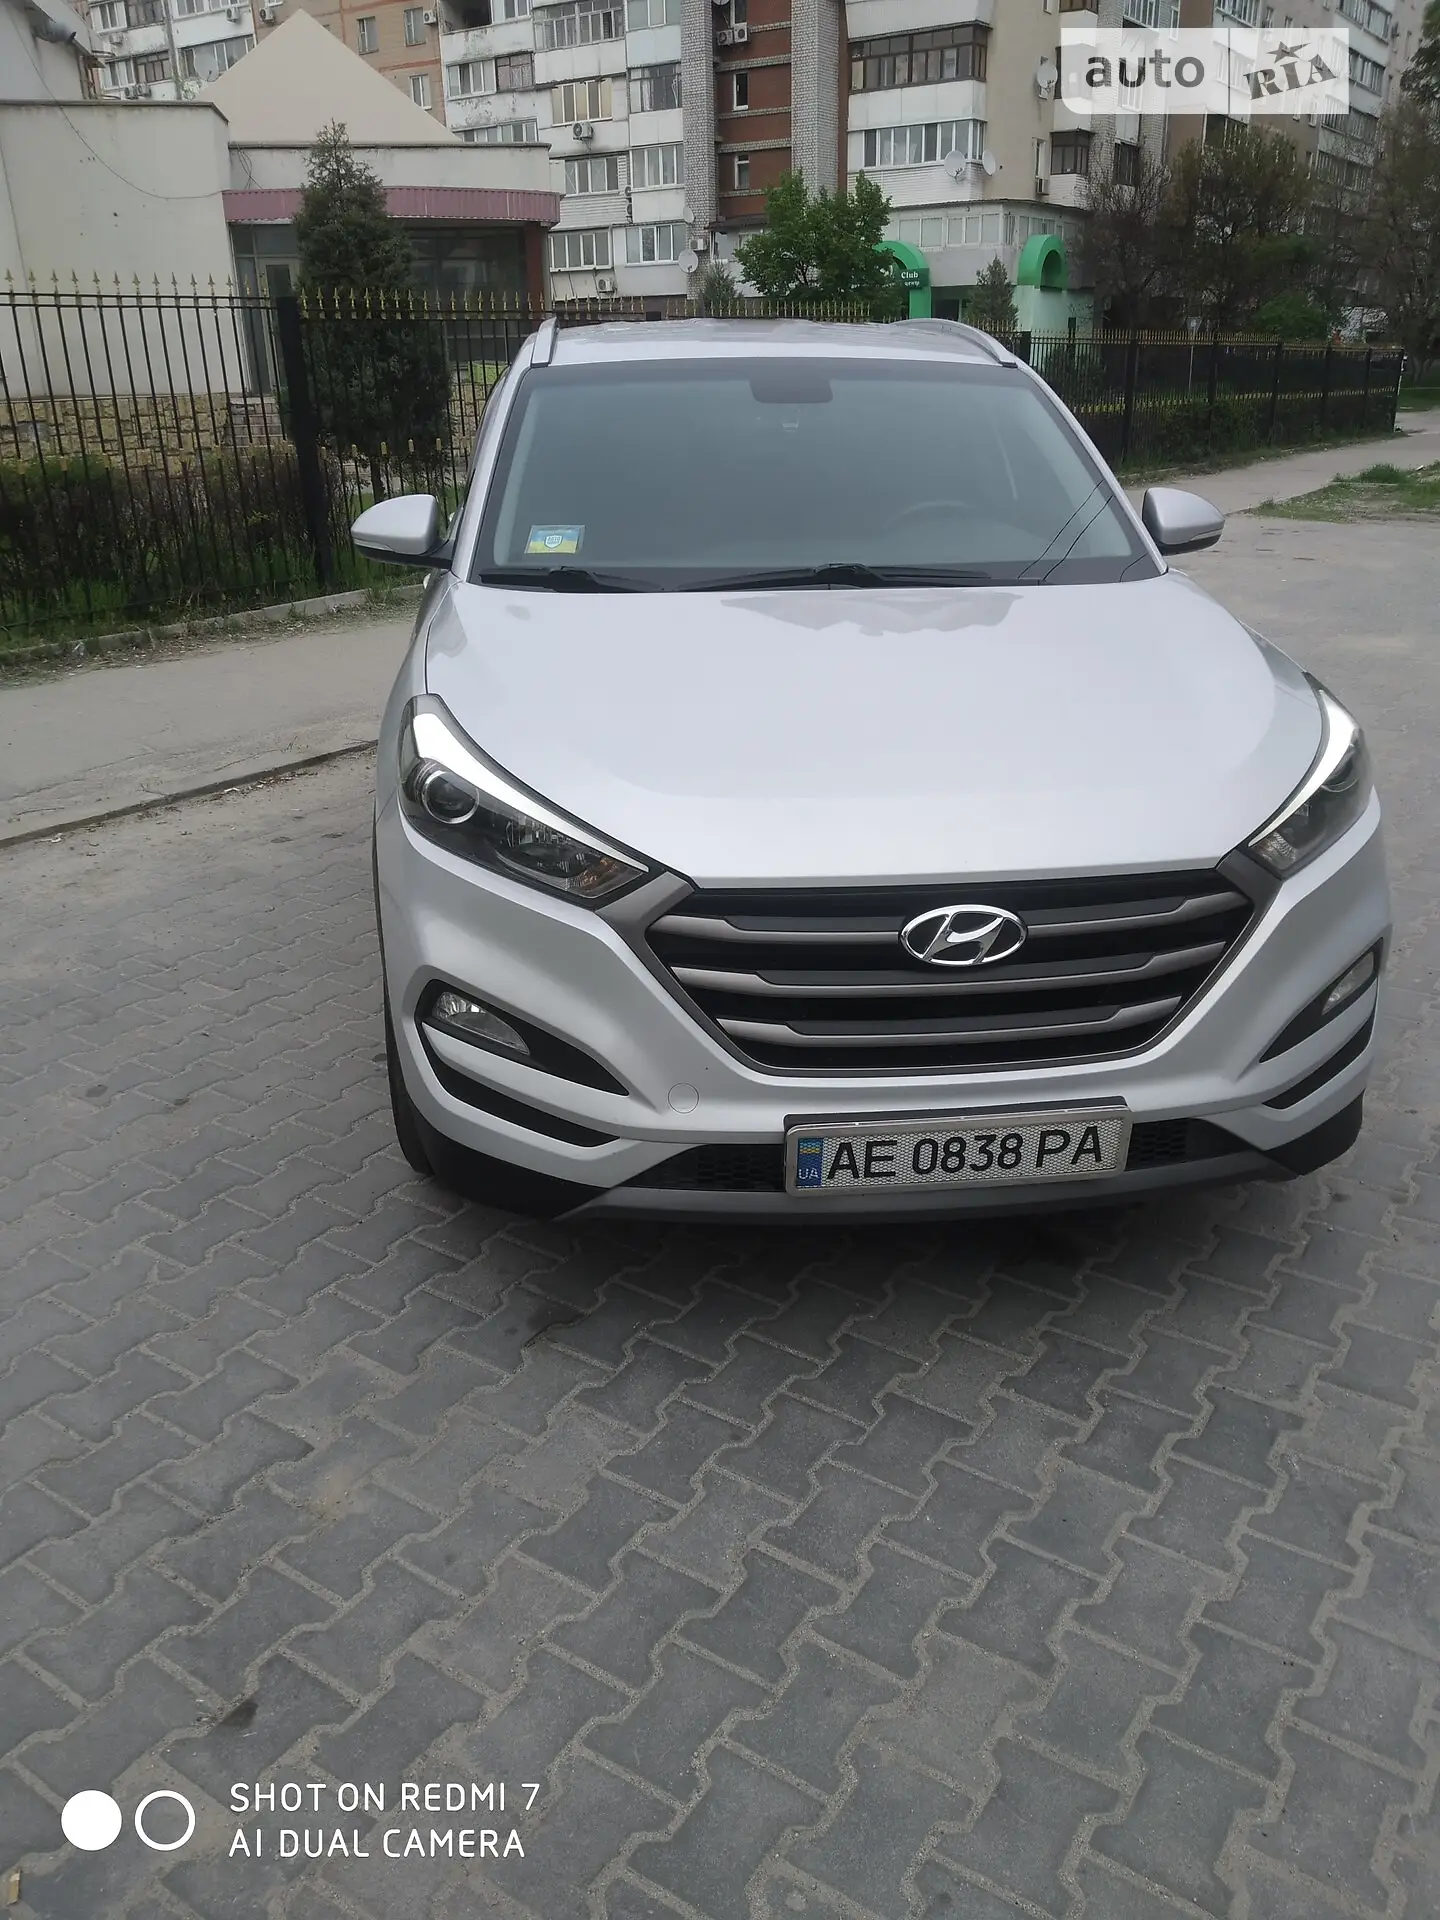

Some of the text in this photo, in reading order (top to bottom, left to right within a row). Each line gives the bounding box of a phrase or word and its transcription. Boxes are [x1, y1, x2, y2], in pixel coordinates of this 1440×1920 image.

[901, 271, 919, 279] Club
[827, 1125, 1102, 1180] AE 0838 PA
[798, 1167, 819, 1181] UA
